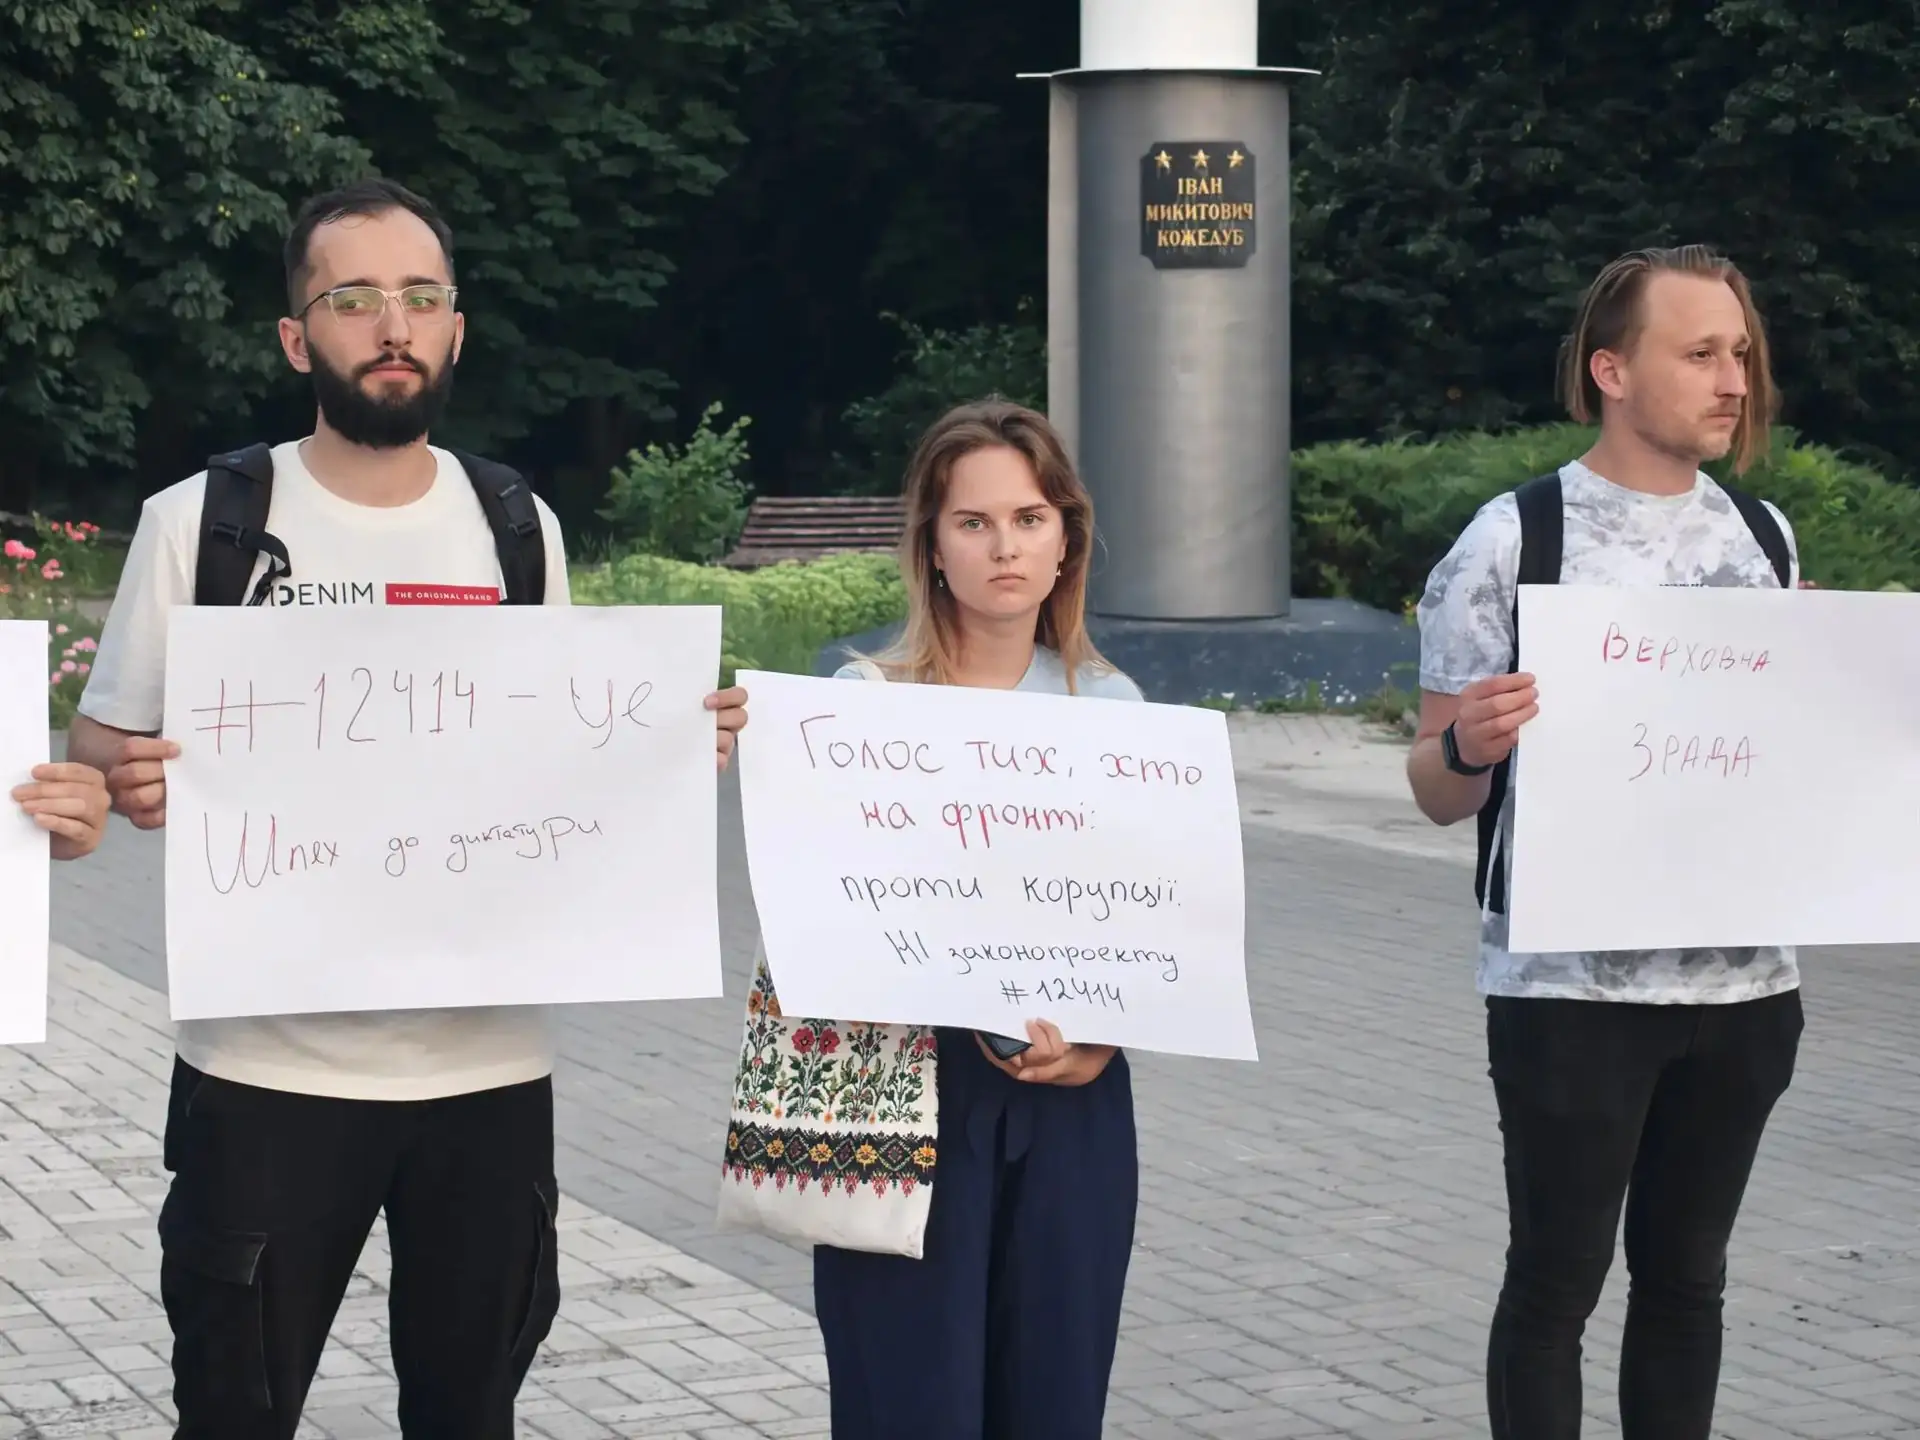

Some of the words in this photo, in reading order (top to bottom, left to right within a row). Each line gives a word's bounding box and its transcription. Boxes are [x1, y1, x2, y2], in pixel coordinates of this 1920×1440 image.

[1178, 177, 1223, 195] ІВАН
[1146, 203, 1253, 221] МИКИТОВИЧ
[1157, 228, 1245, 246] КОЖЕДУБ
[394, 591, 413, 599] THE
[416, 591, 461, 600] ORIGINAL
[191, 667, 475, 753] #12414
[800, 714, 944, 773] Голос
[1100, 752, 1203, 786] хто
[860, 800, 917, 830] на
[384, 836, 420, 877] до
[840, 875, 983, 912] проти
[947, 943, 1180, 983] законопроекту
